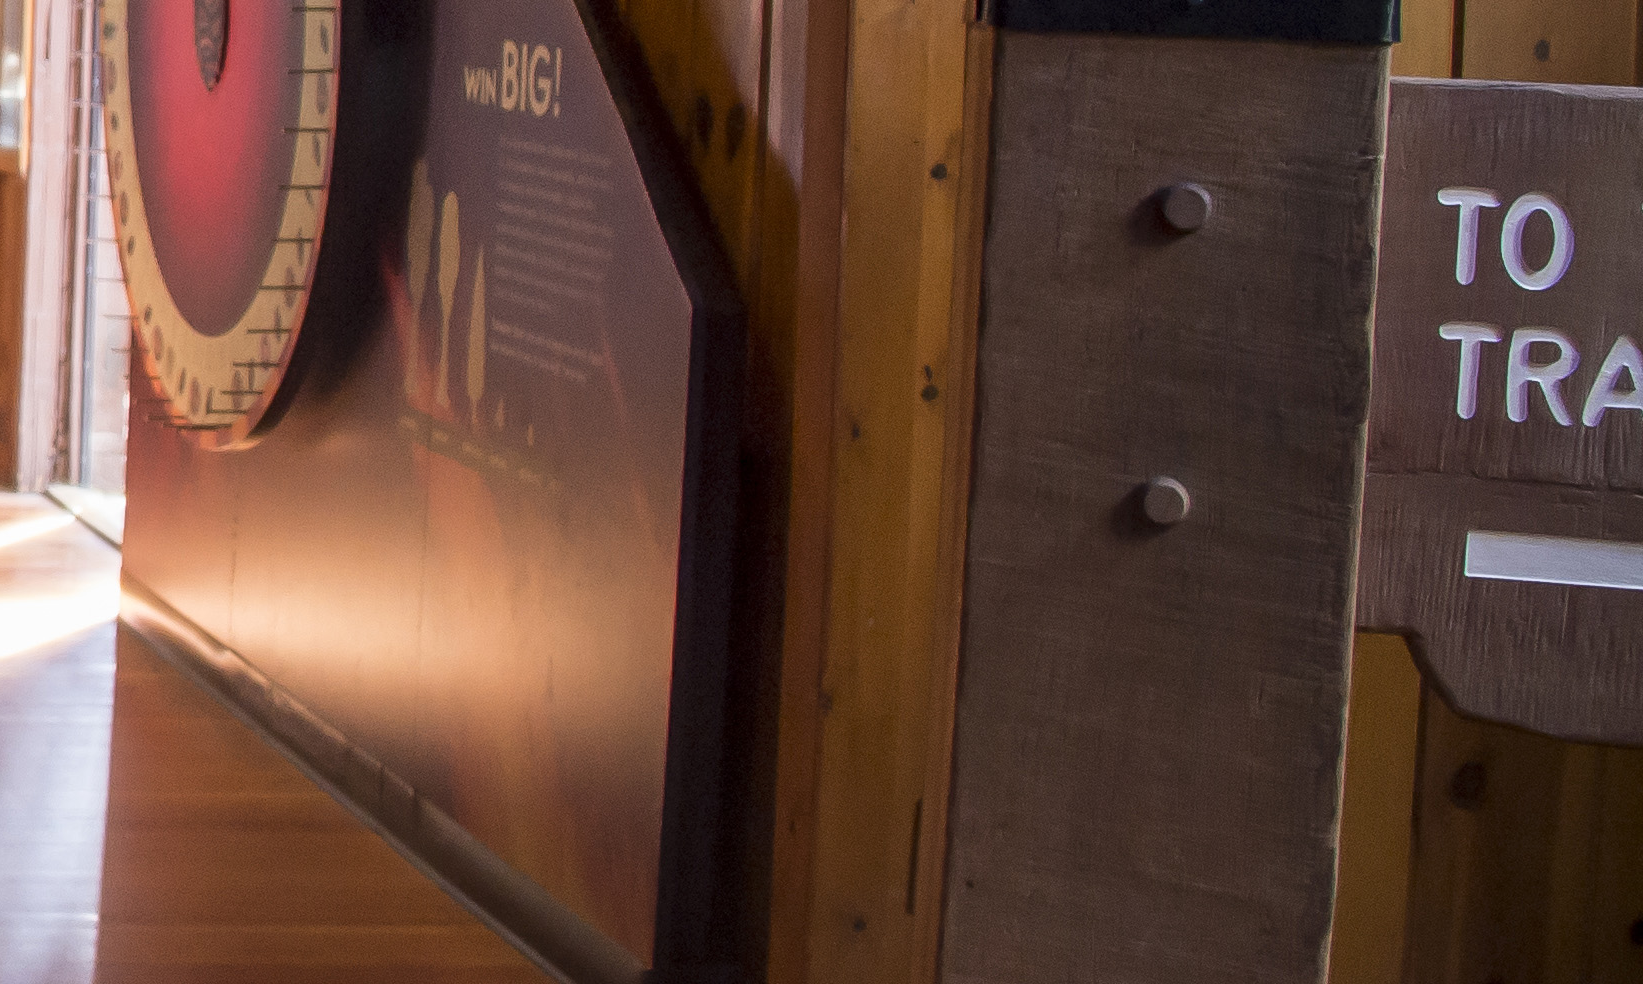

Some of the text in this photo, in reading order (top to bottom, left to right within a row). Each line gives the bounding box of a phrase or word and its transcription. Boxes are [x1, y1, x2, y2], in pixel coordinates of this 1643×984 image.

[464, 37, 564, 118] WIN BIG!
[1436, 185, 1576, 292] TO
[1438, 320, 1643, 428] TRA
